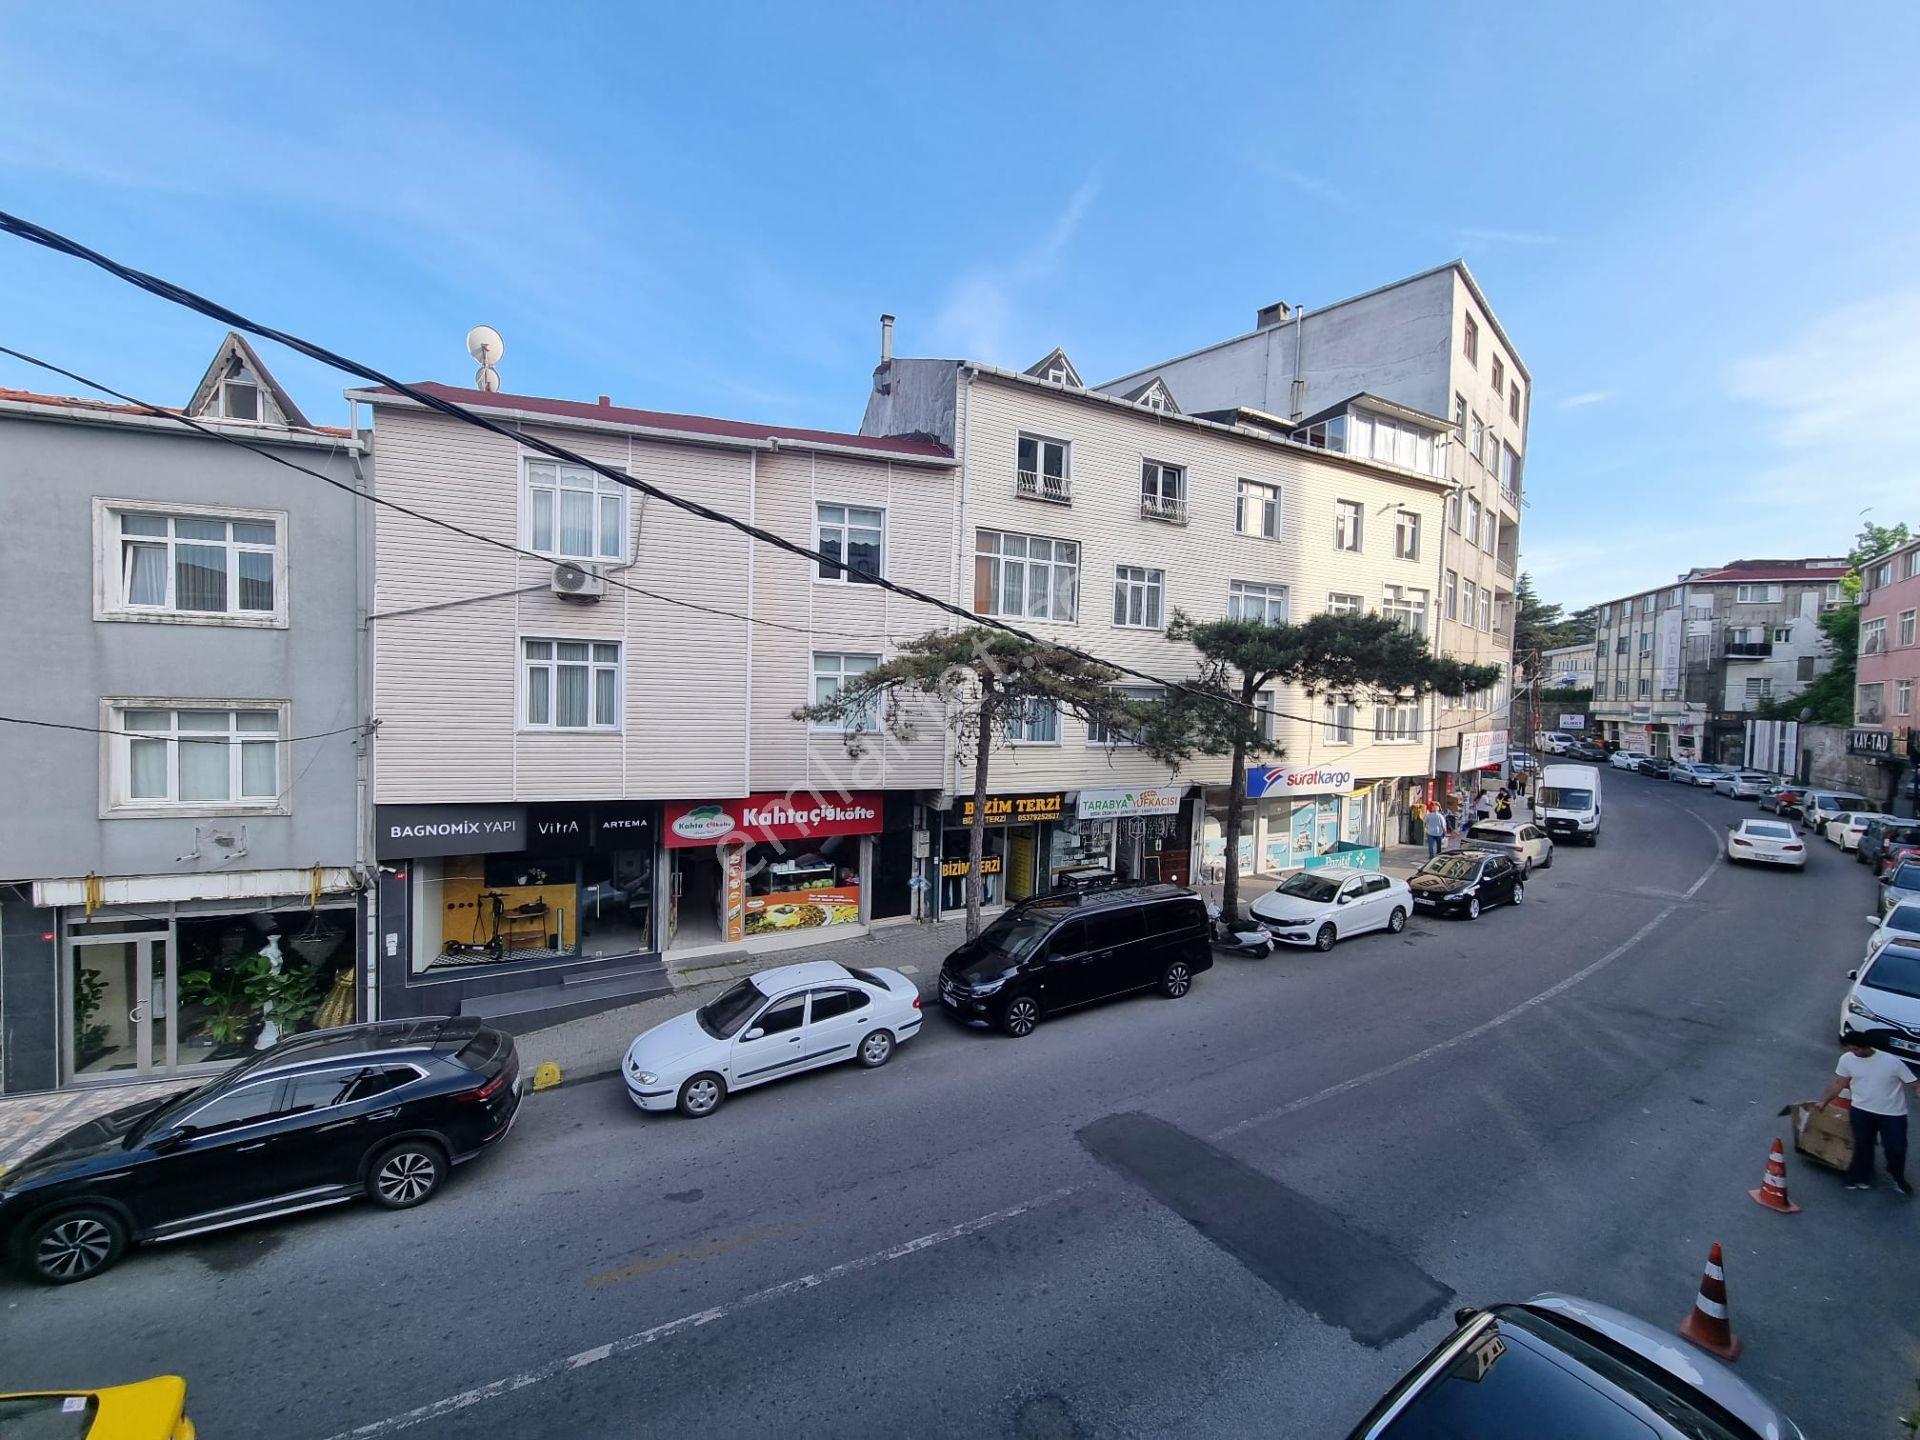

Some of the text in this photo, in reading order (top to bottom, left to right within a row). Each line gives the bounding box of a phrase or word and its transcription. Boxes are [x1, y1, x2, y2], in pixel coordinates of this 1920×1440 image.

[964, 795, 1061, 815] BZİM TERZİ
[1082, 799, 1128, 811] TARABYA
[390, 820, 516, 838] BAGNOMİX YAPI
[538, 821, 579, 834] VitrA
[603, 819, 648, 829] ARTEMA
[942, 856, 1001, 877] BİZİM ERZİ
